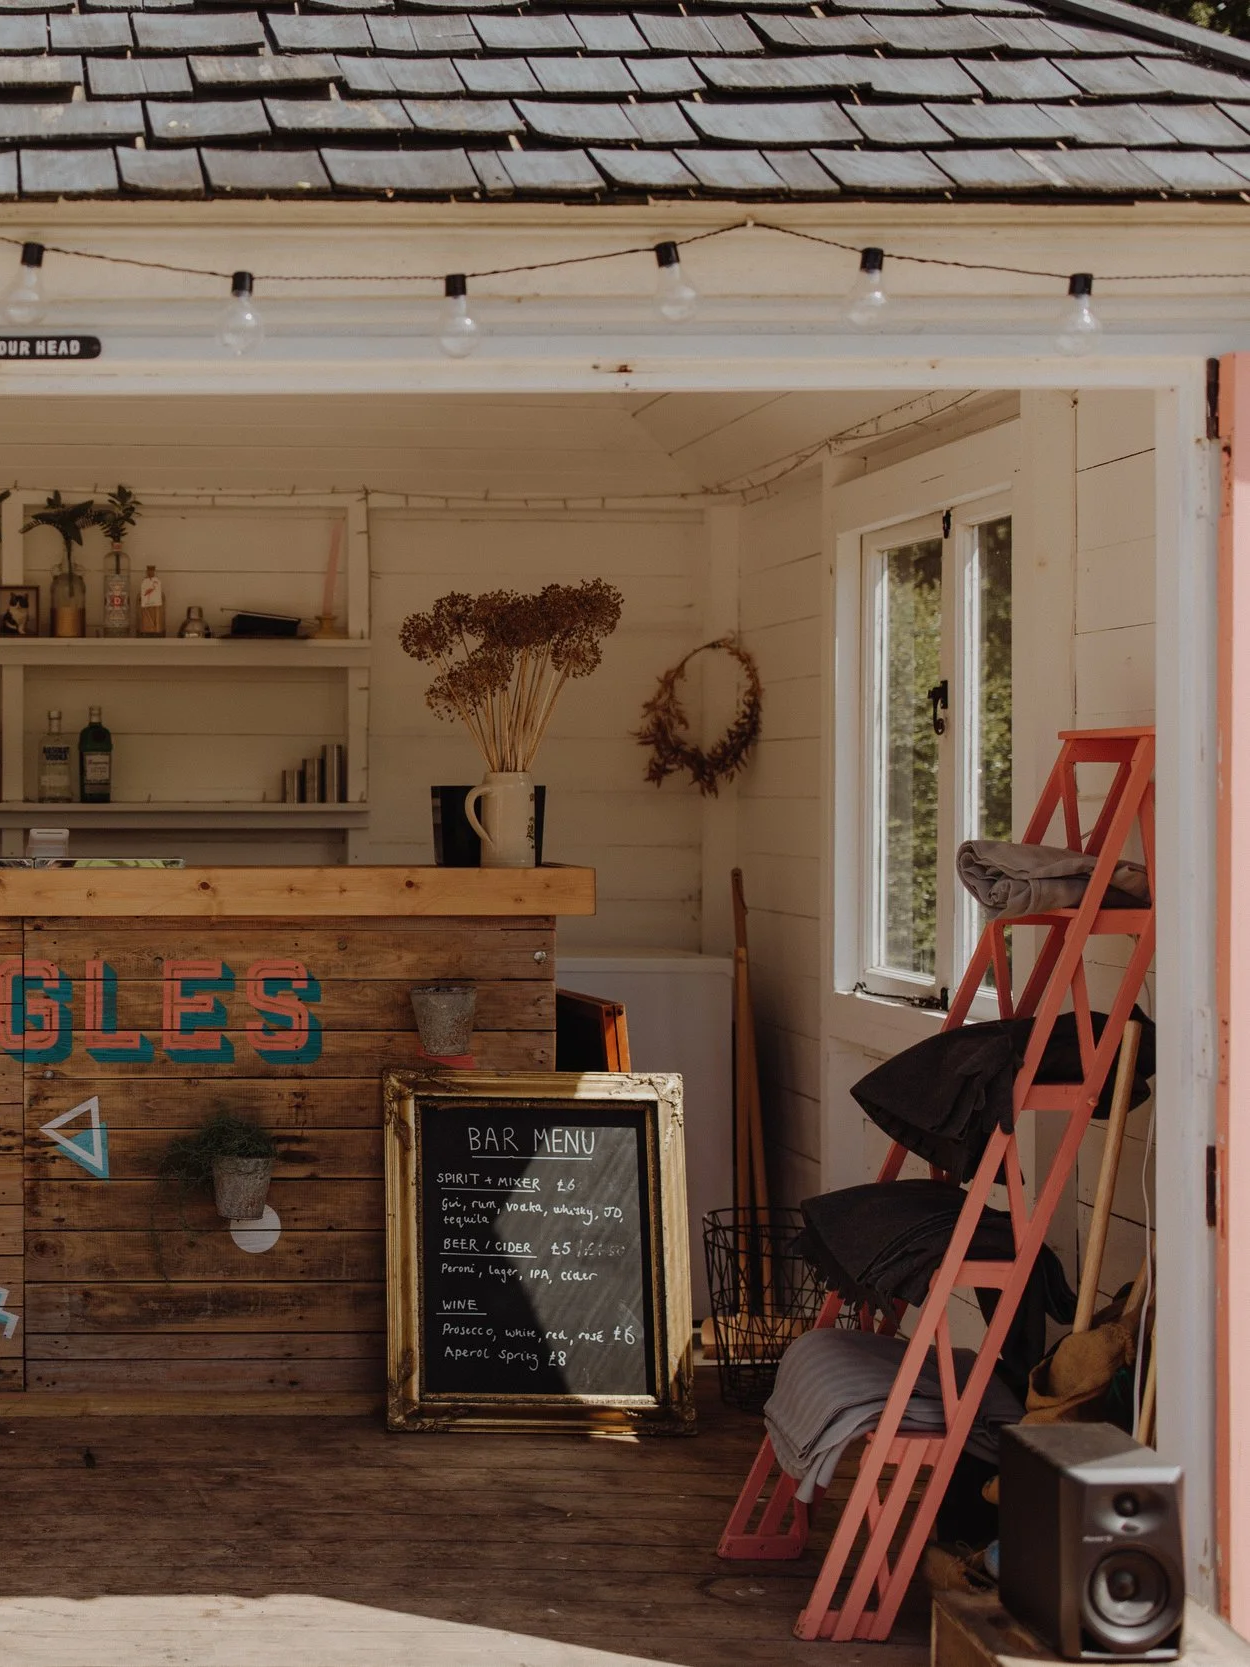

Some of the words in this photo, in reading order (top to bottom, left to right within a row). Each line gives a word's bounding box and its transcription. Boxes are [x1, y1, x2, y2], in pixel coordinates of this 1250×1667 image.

[35, 339, 81, 356] HEAD
[468, 1127, 519, 1152] BAR
[534, 1128, 597, 1154] MENU
[436, 1173, 480, 1184] SPIRIT
[496, 1177, 541, 1191] MIXER
[557, 1178, 577, 1192] £6
[470, 1200, 500, 1215] rum,
[602, 1206, 623, 1223] JD,
[443, 1214, 490, 1228] tequila
[444, 1238, 480, 1252] BEER
[495, 1242, 532, 1254] CIDER
[550, 1242, 572, 1256] £5
[441, 1263, 482, 1278] Peroni,
[529, 1268, 552, 1284] IPA,
[442, 1298, 478, 1311] WINE
[442, 1322, 496, 1342] Prosecco,
[505, 1328, 541, 1342] white,
[545, 1330, 574, 1346] red,
[578, 1330, 605, 1343] rosé
[613, 1325, 636, 1344] £6
[548, 1350, 568, 1366] £8
